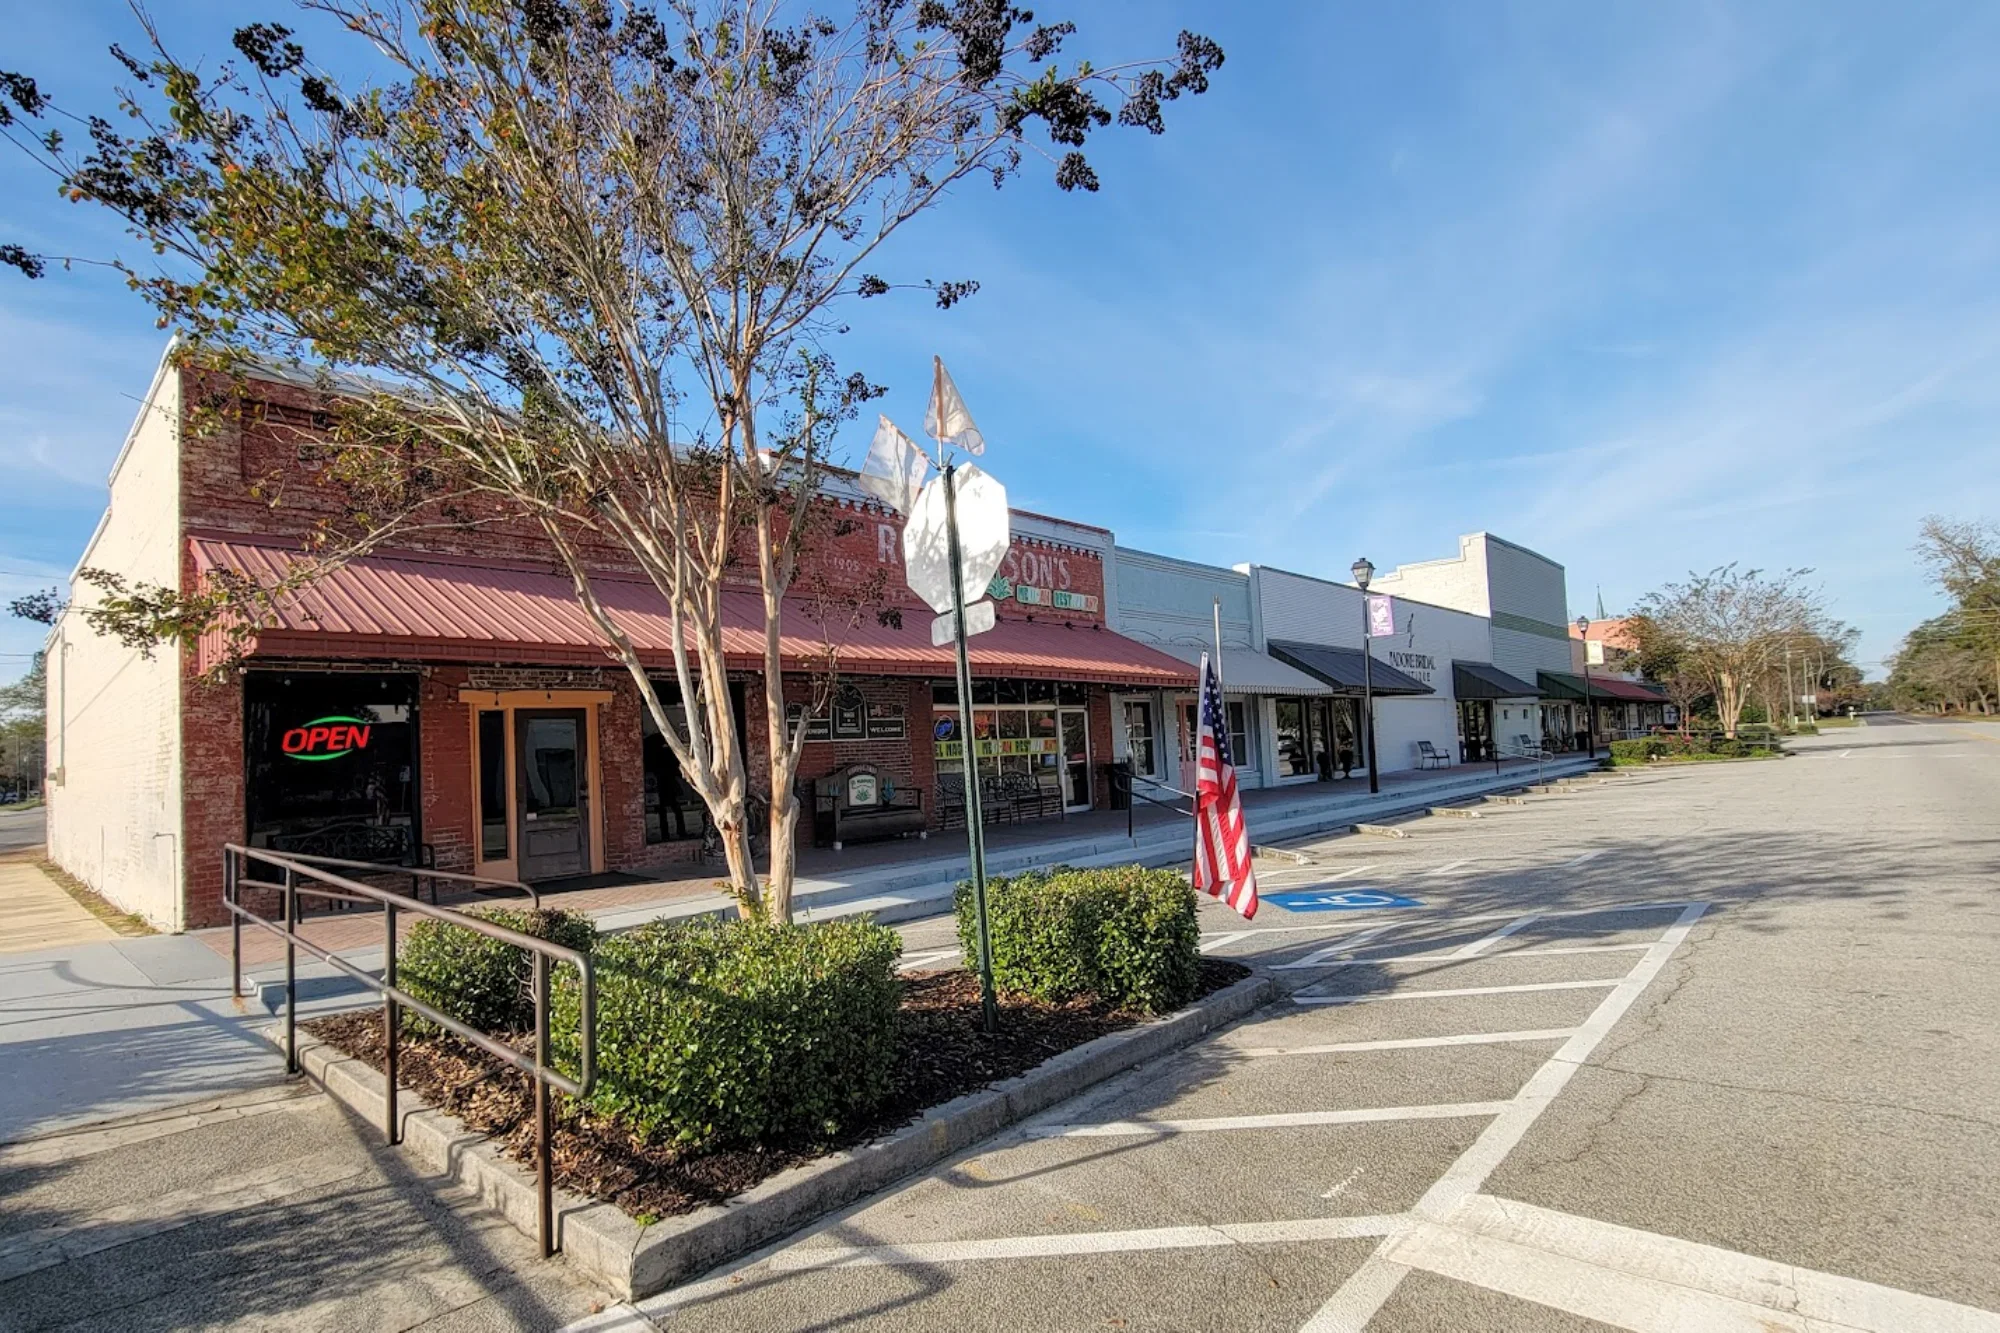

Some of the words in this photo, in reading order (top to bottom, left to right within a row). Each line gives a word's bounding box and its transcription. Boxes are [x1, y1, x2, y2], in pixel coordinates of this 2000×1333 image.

[1416, 654, 1436, 670] BRIDAL
[869, 726, 902, 734] WELCOME
[281, 725, 371, 753] OPEN
